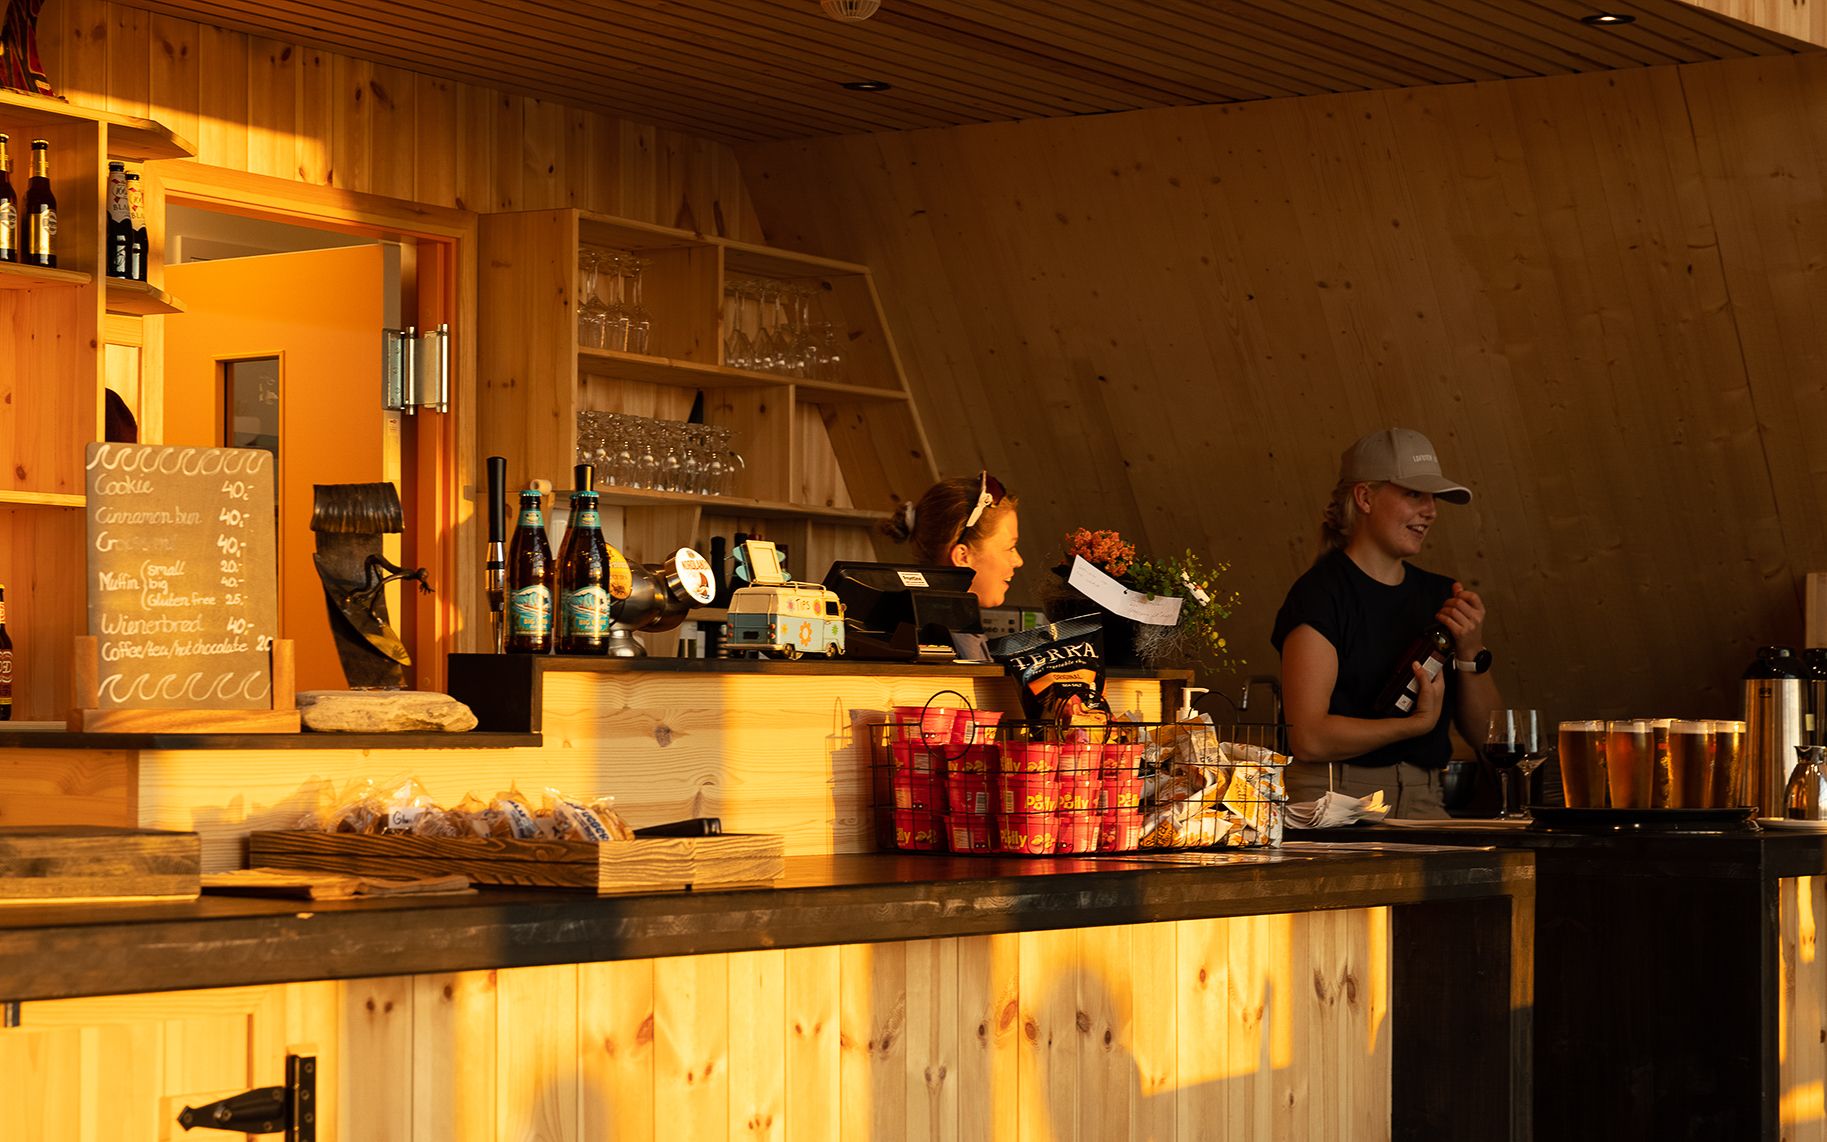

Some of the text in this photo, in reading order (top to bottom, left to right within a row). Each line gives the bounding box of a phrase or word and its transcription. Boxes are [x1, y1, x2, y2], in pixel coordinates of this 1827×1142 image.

[95, 473, 154, 496] Cookie
[95, 506, 174, 525] Cinnamon
[175, 505, 203, 525] bun
[147, 561, 186, 576] small
[98, 571, 139, 591] Muffin
[148, 577, 169, 595] big
[146, 593, 191, 607] Gluten
[191, 592, 217, 605] free
[191, 636, 249, 656] chocolate
[1010, 641, 1099, 671] TERRA
[1025, 793, 1056, 811] Polly
[1060, 794, 1089, 810] Polly
